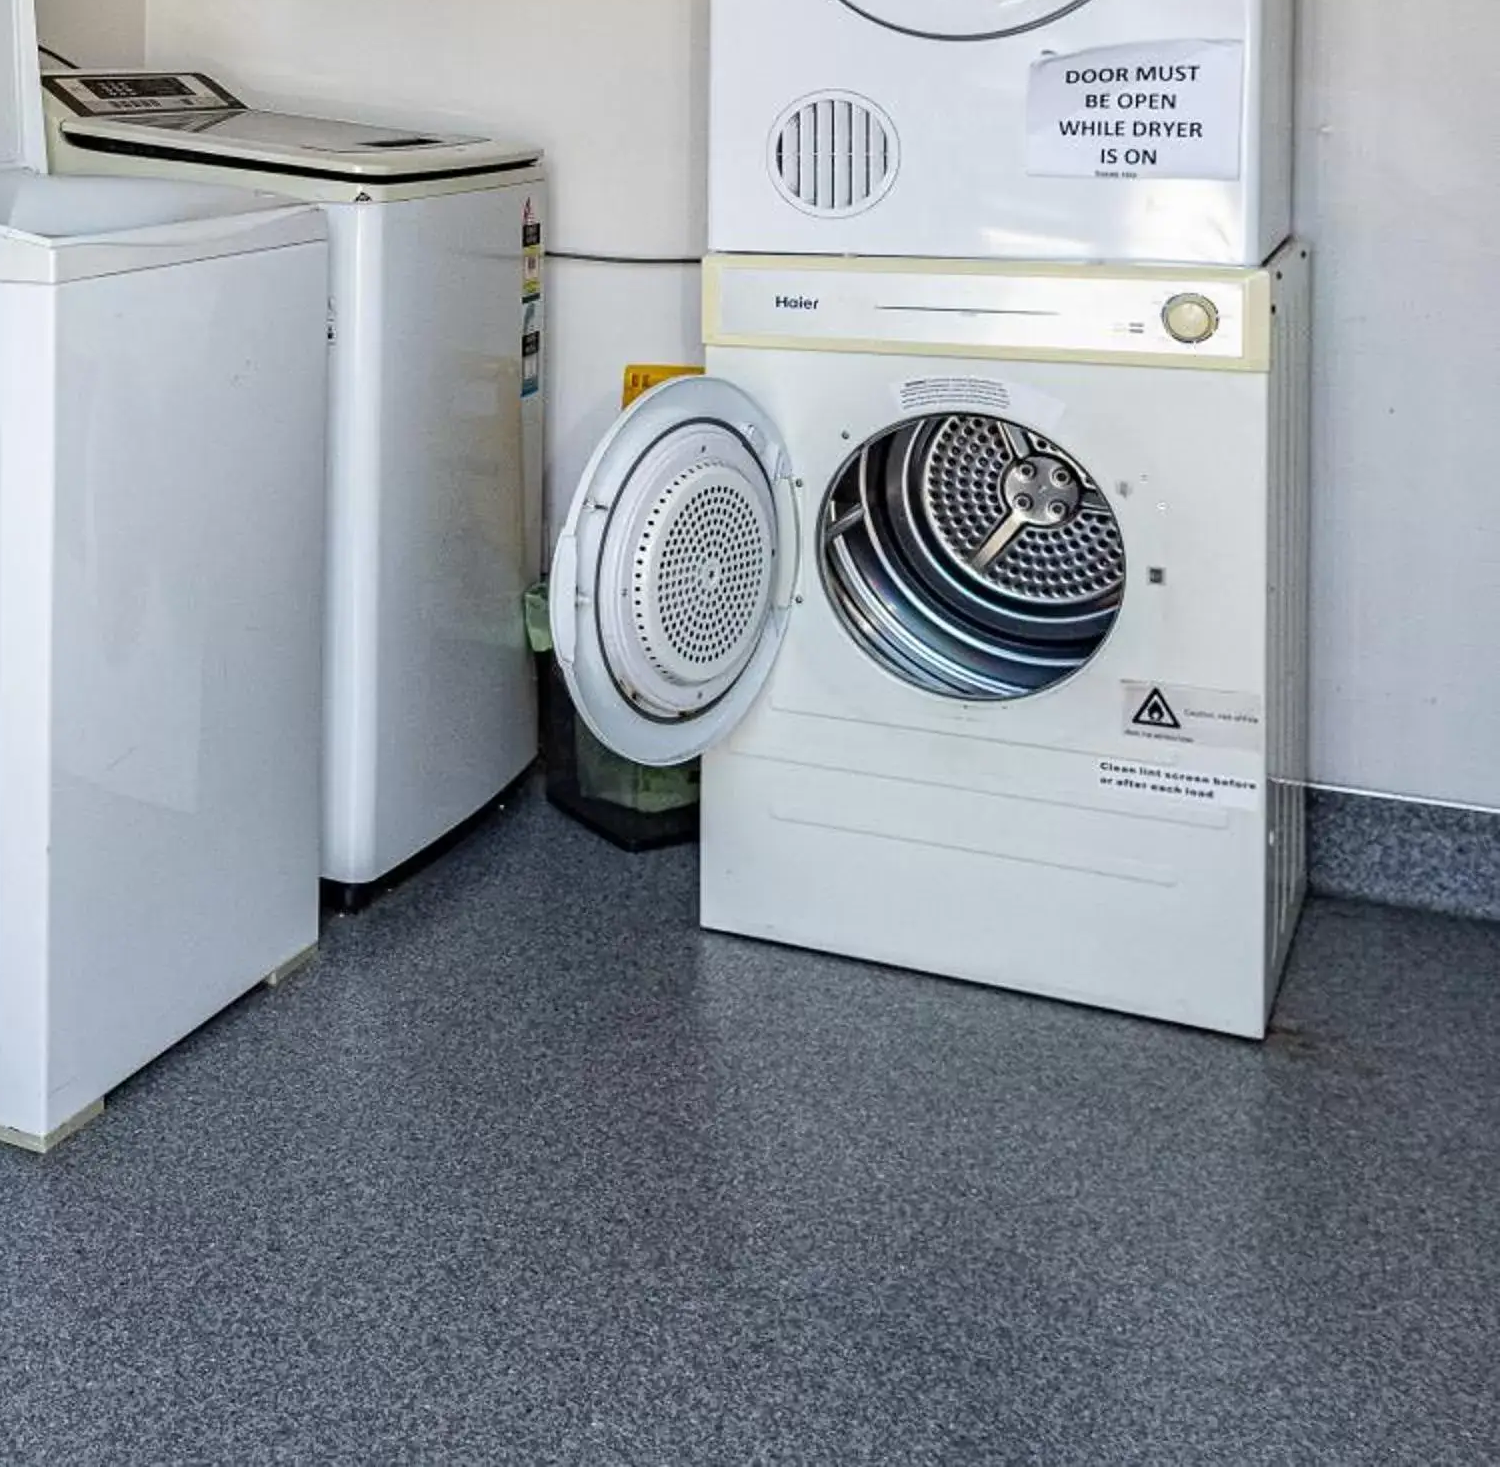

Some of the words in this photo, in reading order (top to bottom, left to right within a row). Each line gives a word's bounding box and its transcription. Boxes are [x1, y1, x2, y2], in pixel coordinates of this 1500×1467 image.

[1065, 67, 1130, 84] DOOR
[1135, 65, 1201, 83] MUST
[1085, 93, 1110, 109] BE
[1117, 93, 1177, 110] OPEN
[1059, 120, 1125, 137] WHILE
[1133, 121, 1203, 138] DRYER
[1100, 148, 1118, 165] IS
[1124, 148, 1157, 165] ON
[775, 295, 820, 310] Haier
[1100, 761, 1137, 774] Clean
[1139, 766, 1161, 778] lint
[1164, 772, 1210, 784] screen
[1213, 776, 1257, 790] before
[1116, 777, 1147, 789] after
[1150, 783, 1182, 794] each
[1185, 786, 1214, 799] load
